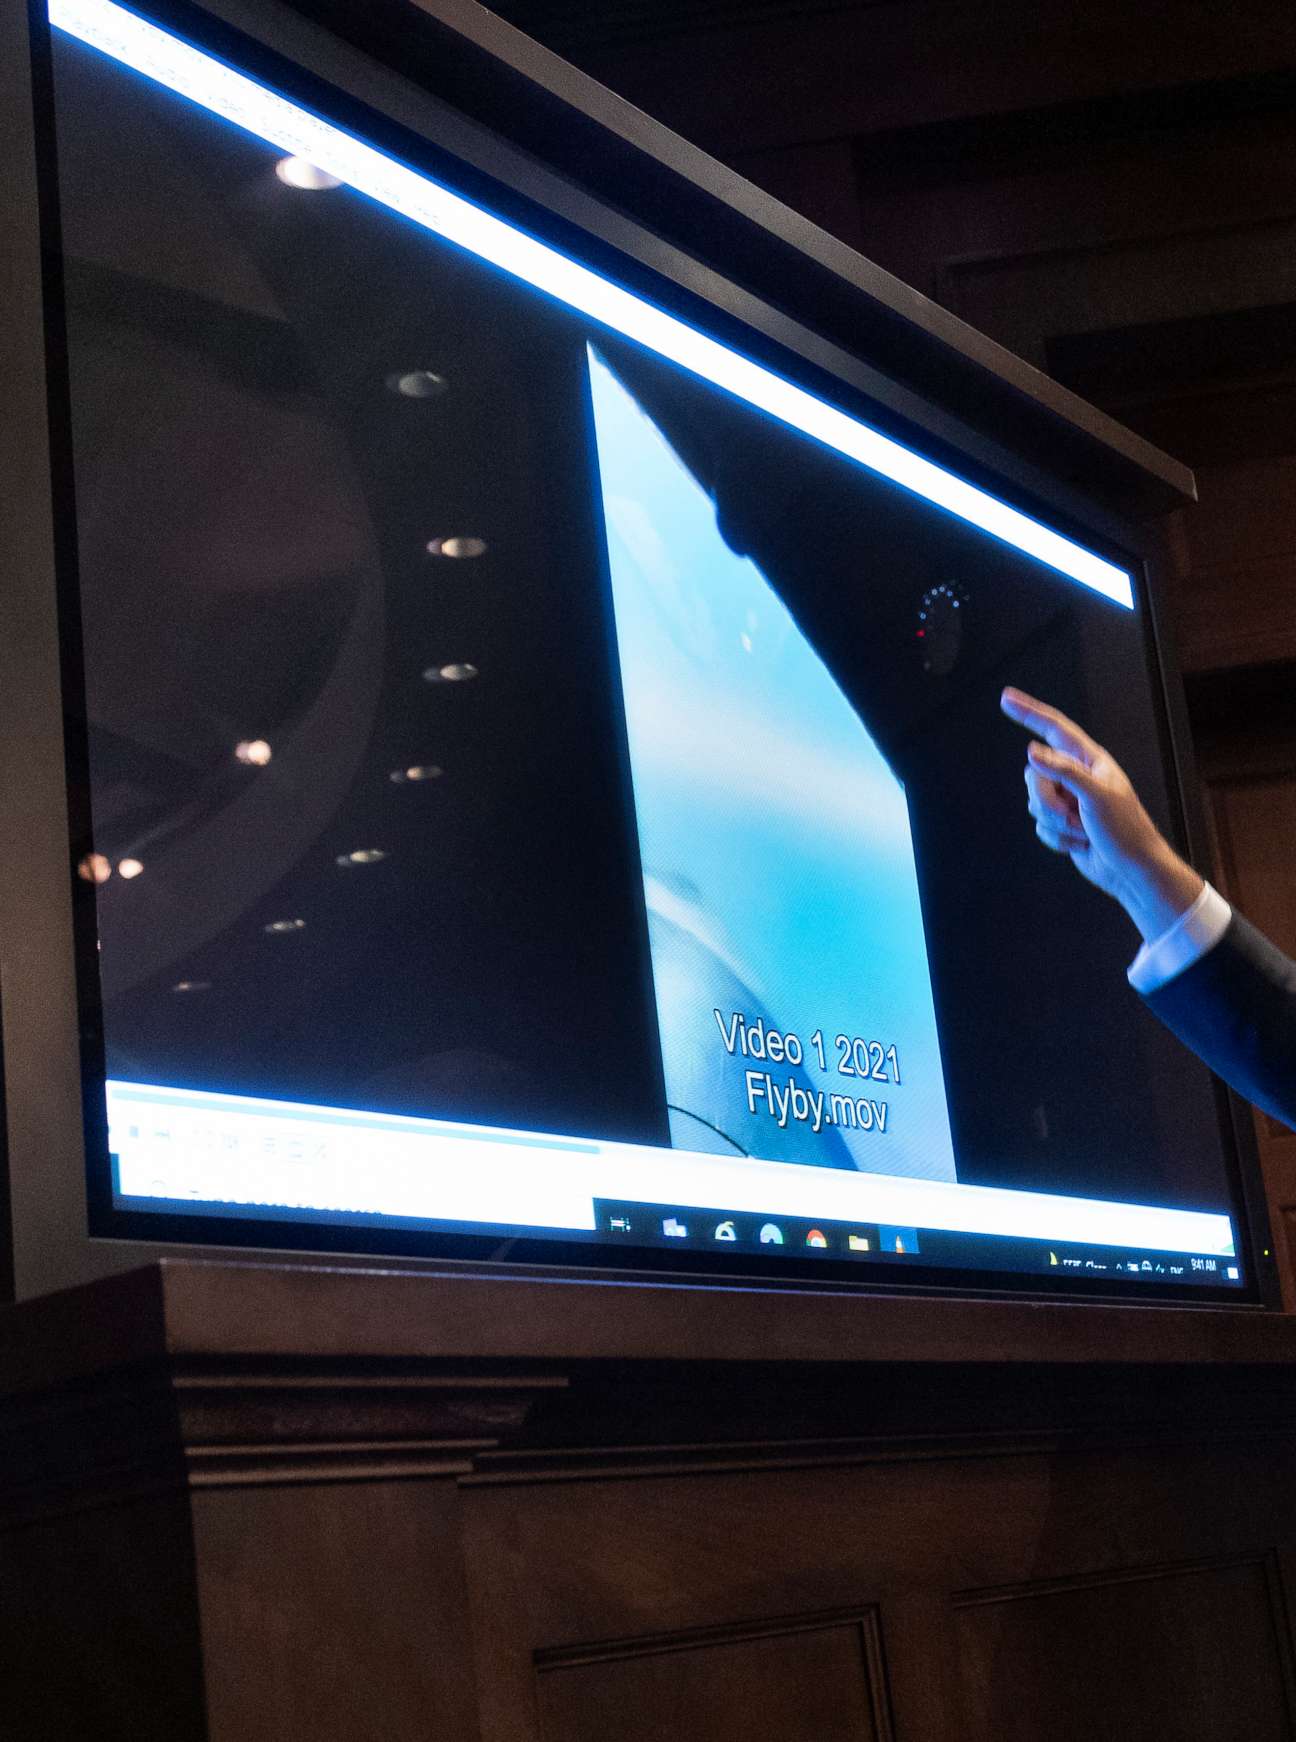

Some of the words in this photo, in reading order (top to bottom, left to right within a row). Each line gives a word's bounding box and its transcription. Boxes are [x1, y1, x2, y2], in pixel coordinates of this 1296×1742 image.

[714, 1008, 802, 1065] Video
[811, 1029, 826, 1071] 1
[835, 1034, 901, 1085] 2021
[746, 1070, 887, 1133] Flyby.mov
